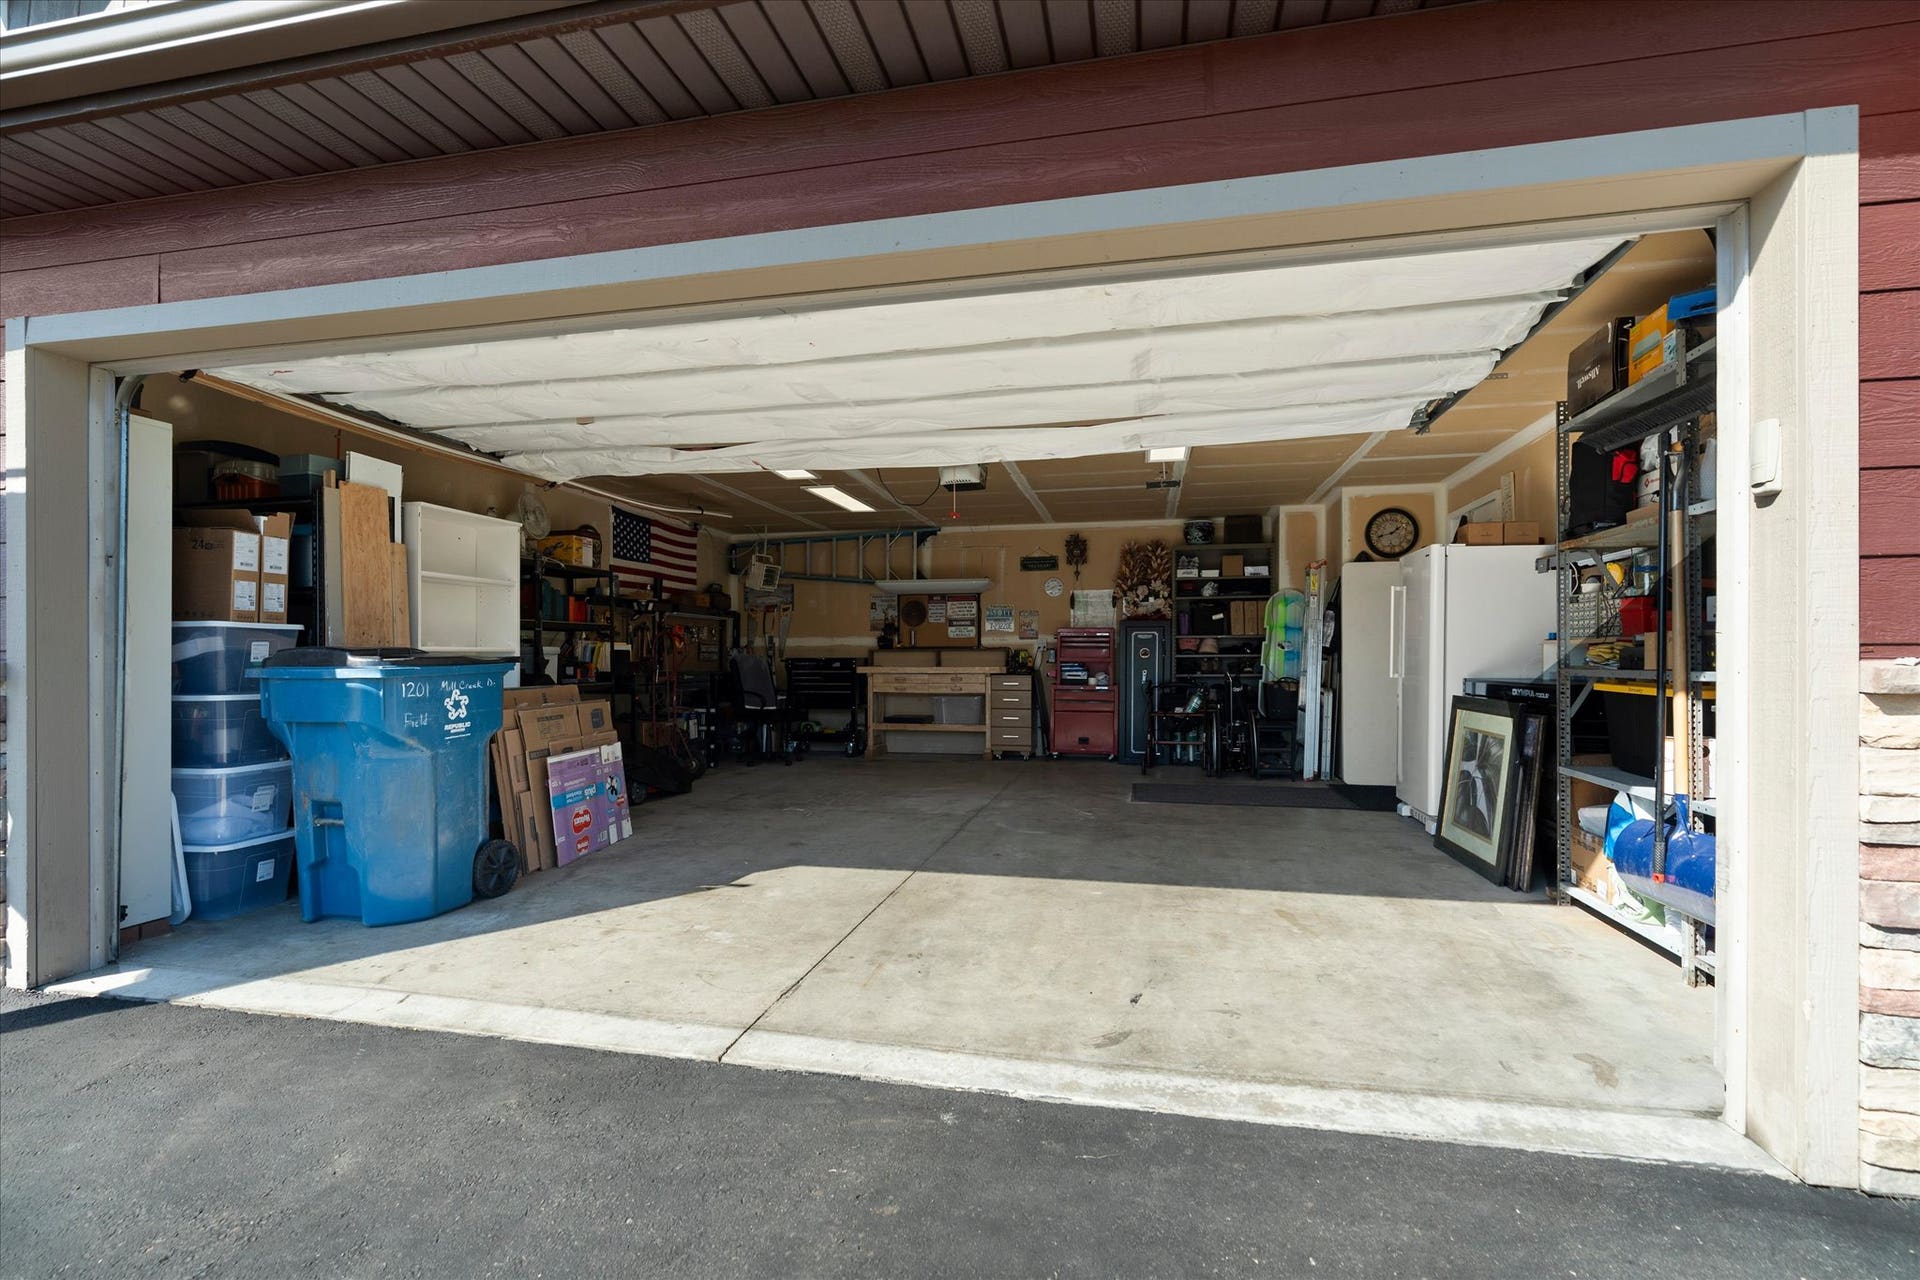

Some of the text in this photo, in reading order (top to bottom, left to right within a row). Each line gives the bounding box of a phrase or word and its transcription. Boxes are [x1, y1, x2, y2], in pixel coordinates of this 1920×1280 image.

[401, 681, 430, 698] 1201
[440, 680, 457, 691] Mill
[459, 680, 484, 690] Creek
[404, 712, 430, 729] Field
[444, 721, 471, 731] REPUBLIC
